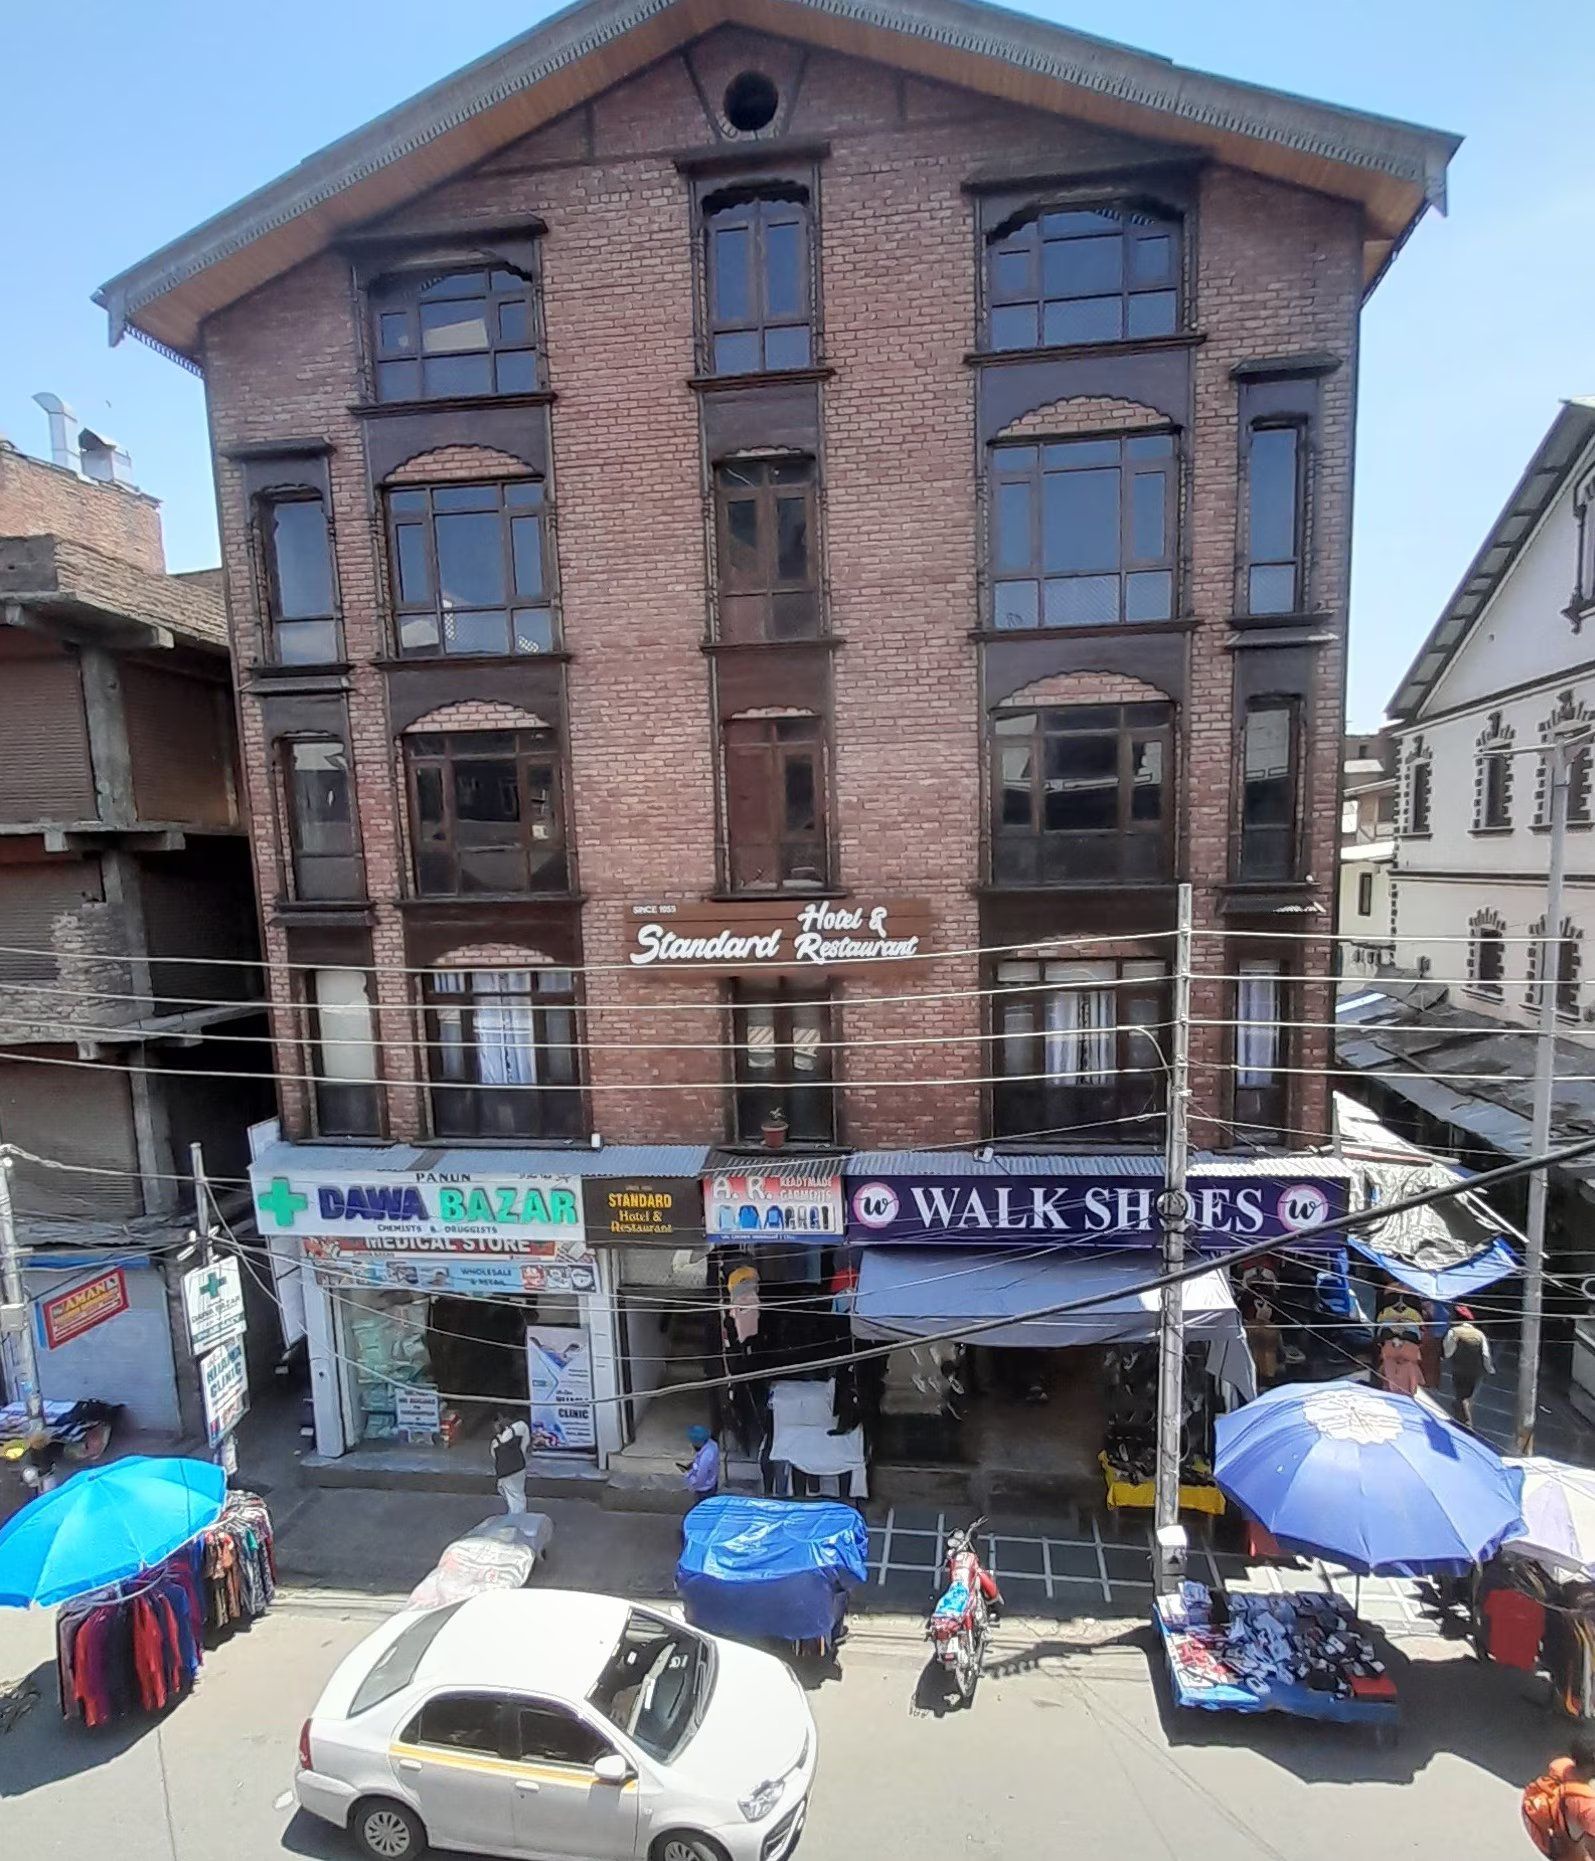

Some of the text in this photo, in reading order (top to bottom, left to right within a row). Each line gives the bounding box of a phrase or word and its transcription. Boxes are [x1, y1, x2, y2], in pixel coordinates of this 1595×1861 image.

[633, 905, 658, 914] SINCE
[797, 901, 887, 938] Hotel &
[629, 924, 783, 965] Standard
[794, 932, 919, 965] Restaurant
[416, 1173, 471, 1182] PANUN
[318, 1185, 581, 1225] DAWA BAZAR
[608, 1193, 673, 1208] STANDARD
[910, 1187, 1072, 1229] WALK
[619, 1210, 662, 1222] Hotel &
[377, 1224, 422, 1233] CHEMISTS
[445, 1226, 498, 1234] DRUGGISTS
[610, 1220, 673, 1233] Restaurant
[365, 1237, 531, 1252] MEDICAL STORE
[461, 1267, 512, 1276] WHOLESALE
[558, 1408, 590, 1419] CLINIC
